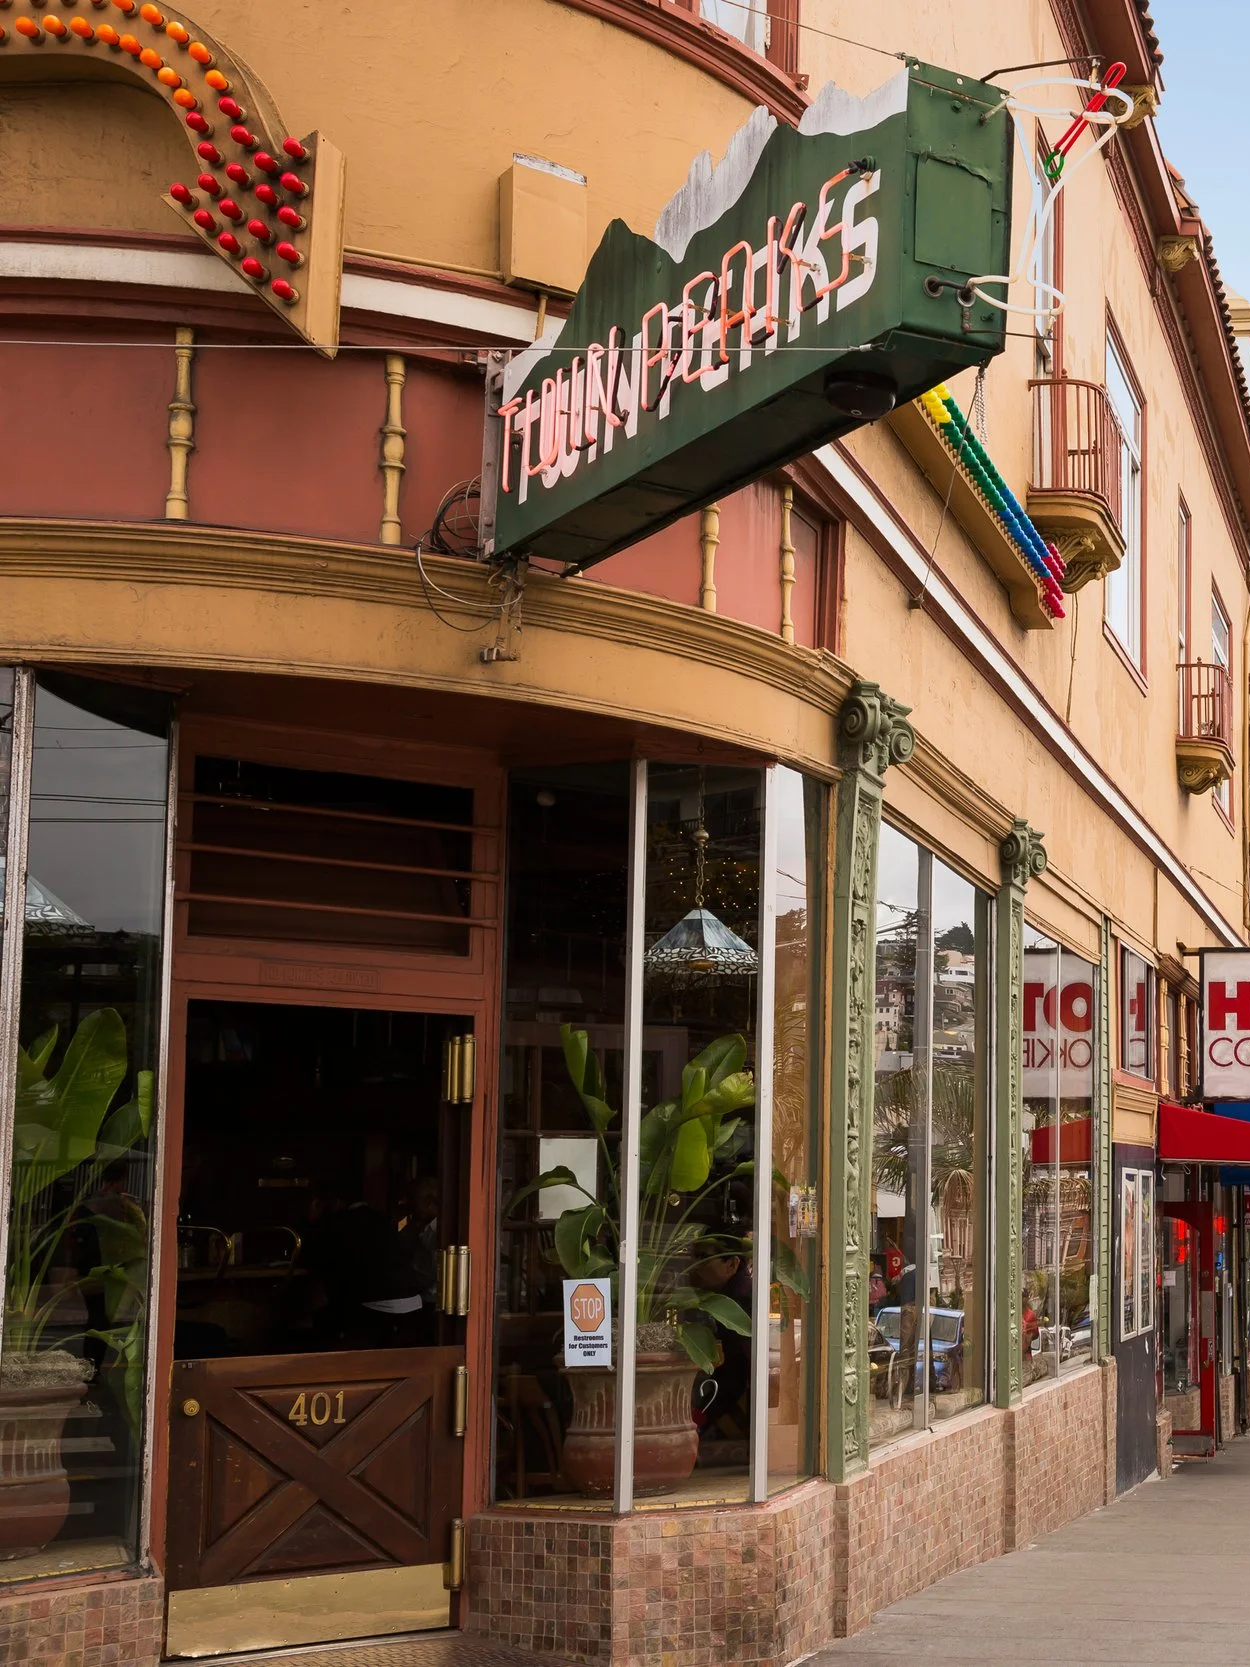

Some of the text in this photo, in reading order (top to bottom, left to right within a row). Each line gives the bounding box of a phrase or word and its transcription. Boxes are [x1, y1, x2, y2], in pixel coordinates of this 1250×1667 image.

[642, 163, 882, 420] PEAKS
[573, 1297, 602, 1320] STOP
[288, 1390, 346, 1426] 401
